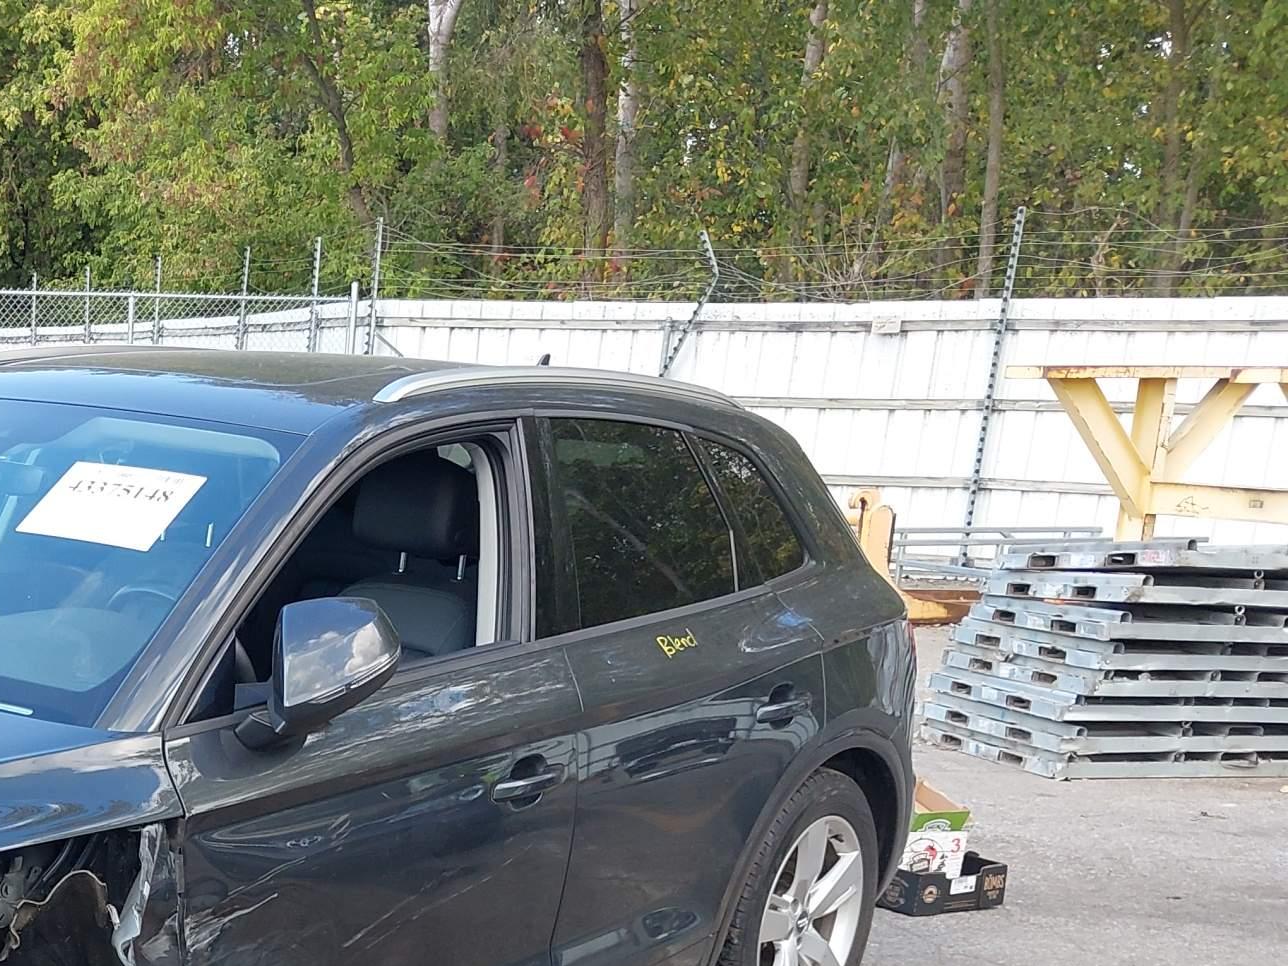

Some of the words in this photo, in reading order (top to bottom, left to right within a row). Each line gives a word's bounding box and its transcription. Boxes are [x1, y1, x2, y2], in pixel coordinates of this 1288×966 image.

[69, 480, 174, 502] 43375148
[656, 627, 699, 659] Blend
[951, 837, 961, 853] 3
